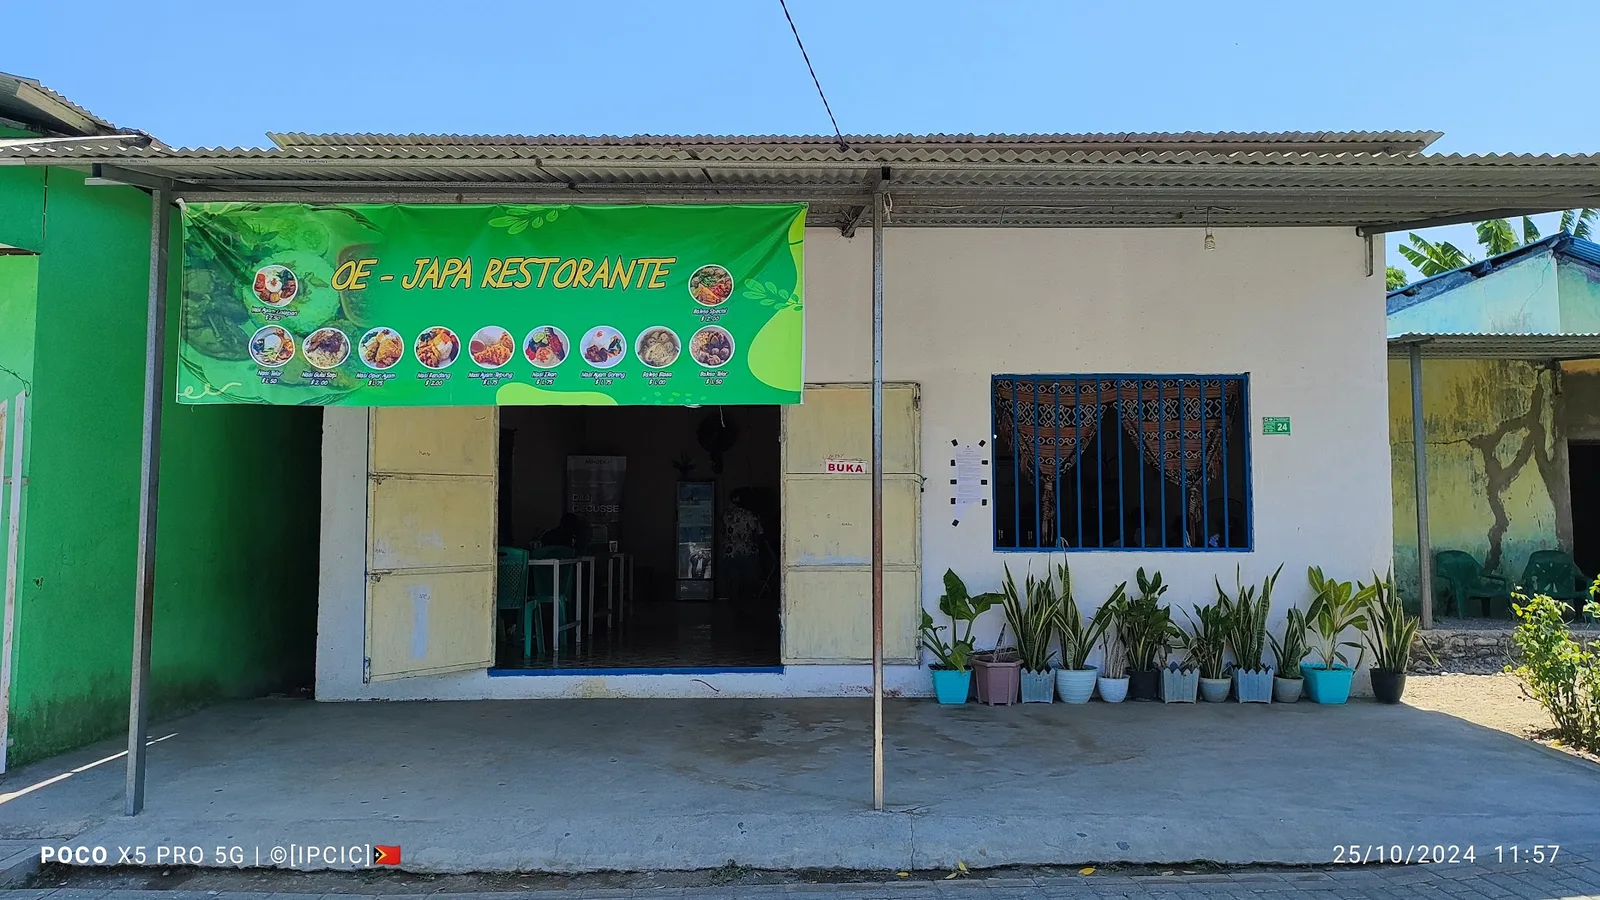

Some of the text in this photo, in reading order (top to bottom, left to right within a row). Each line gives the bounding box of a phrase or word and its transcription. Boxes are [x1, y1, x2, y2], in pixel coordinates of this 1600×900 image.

[331, 258, 378, 290] OE
[401, 254, 472, 290] JAPA
[480, 254, 676, 291] RESTORANTE
[326, 371, 337, 379] Sapi
[428, 372, 451, 380] Rendang
[480, 371, 493, 379] Ayam
[494, 371, 513, 379] Tepung
[593, 371, 607, 379] Ayam
[607, 371, 626, 379] Goreng
[1277, 423, 1288, 431] 24
[828, 463, 863, 472] BUKA
